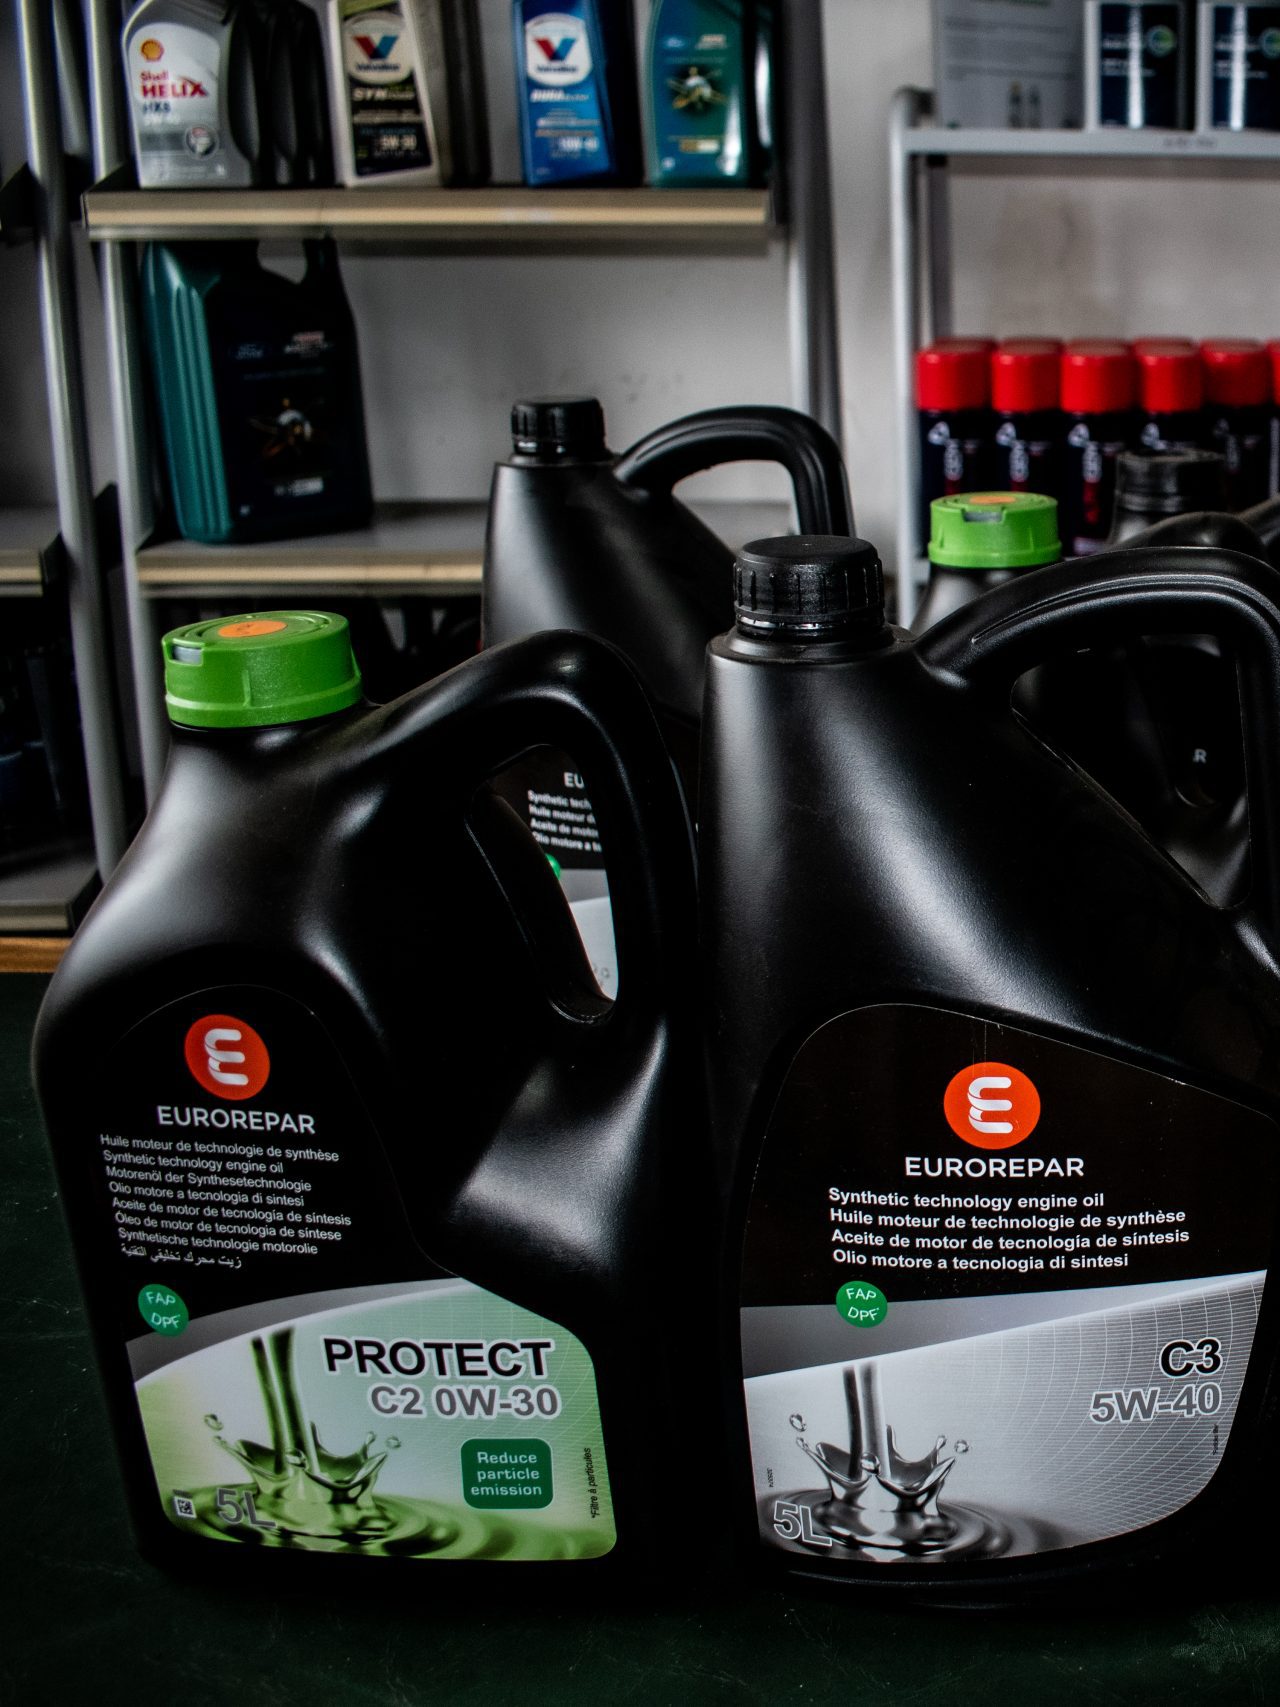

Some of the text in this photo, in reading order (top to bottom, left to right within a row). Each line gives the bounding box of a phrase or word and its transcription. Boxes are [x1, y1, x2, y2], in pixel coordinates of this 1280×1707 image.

[140, 70, 168, 82] Shell
[141, 76, 208, 98] HELIX
[157, 1105, 315, 1134] EUROREPAR
[100, 1134, 339, 1162] Huile moteur de technologie de synthèse
[103, 1150, 283, 1175] Synthetic technology engine oil
[905, 1157, 1085, 1178] EUROREPAR
[106, 1166, 312, 1193] Motorenöl der Synthesetechnologie
[109, 1182, 304, 1207] Olio motore a tecnologia di sintesi
[829, 1187, 1104, 1211] Synthetic technology engine oil
[829, 1208, 1186, 1231] Huile moteur de technologie de synthèse
[831, 1229, 1190, 1252] Aceite de motor de tecnología de síntesis
[833, 1249, 1129, 1273] Olio motore a tecnologia di sintesi
[146, 1291, 176, 1306] FAP
[846, 1288, 876, 1300] FAP
[322, 1336, 553, 1378] PROTECT
[1160, 1337, 1223, 1378] C3
[370, 1385, 560, 1418] C2 0W-30
[1091, 1382, 1222, 1424] 5W-40
[476, 1451, 538, 1464] Reduce
[477, 1467, 540, 1482] particle
[470, 1484, 542, 1496] emission
[216, 1488, 277, 1528] 5L
[774, 1500, 832, 1547] 5L
